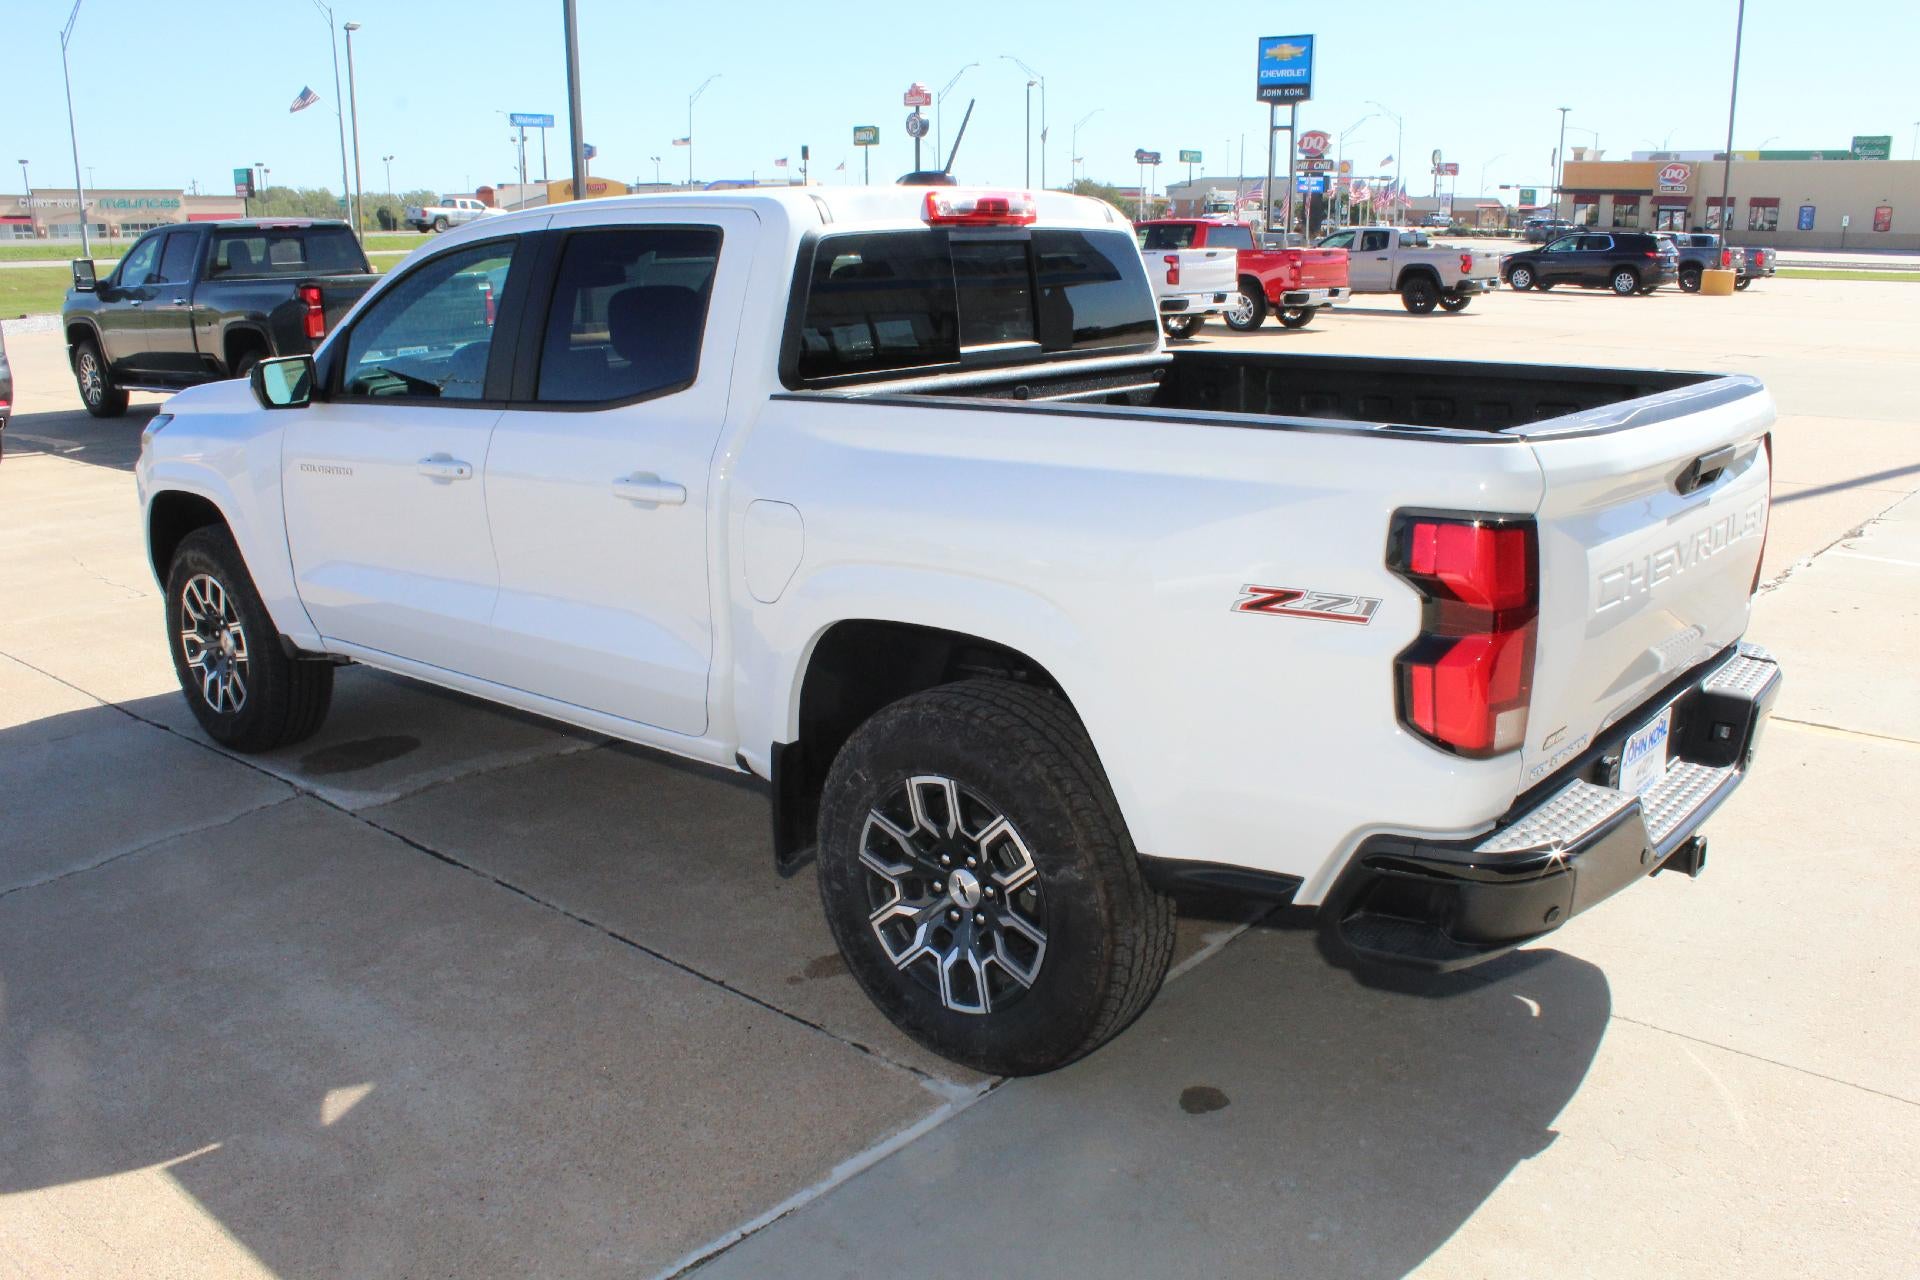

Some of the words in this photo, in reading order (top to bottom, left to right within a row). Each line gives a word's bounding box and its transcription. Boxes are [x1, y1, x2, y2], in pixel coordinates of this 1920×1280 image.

[1260, 69, 1307, 78] CHEVROLET
[1262, 88, 1282, 97] JOHN
[1284, 88, 1304, 97] KOHL
[515, 115, 544, 125] Walmart
[1302, 136, 1324, 151] DQ
[1666, 168, 1685, 179] DQ
[99, 198, 181, 209] maurices
[1230, 584, 1383, 626] Z71
